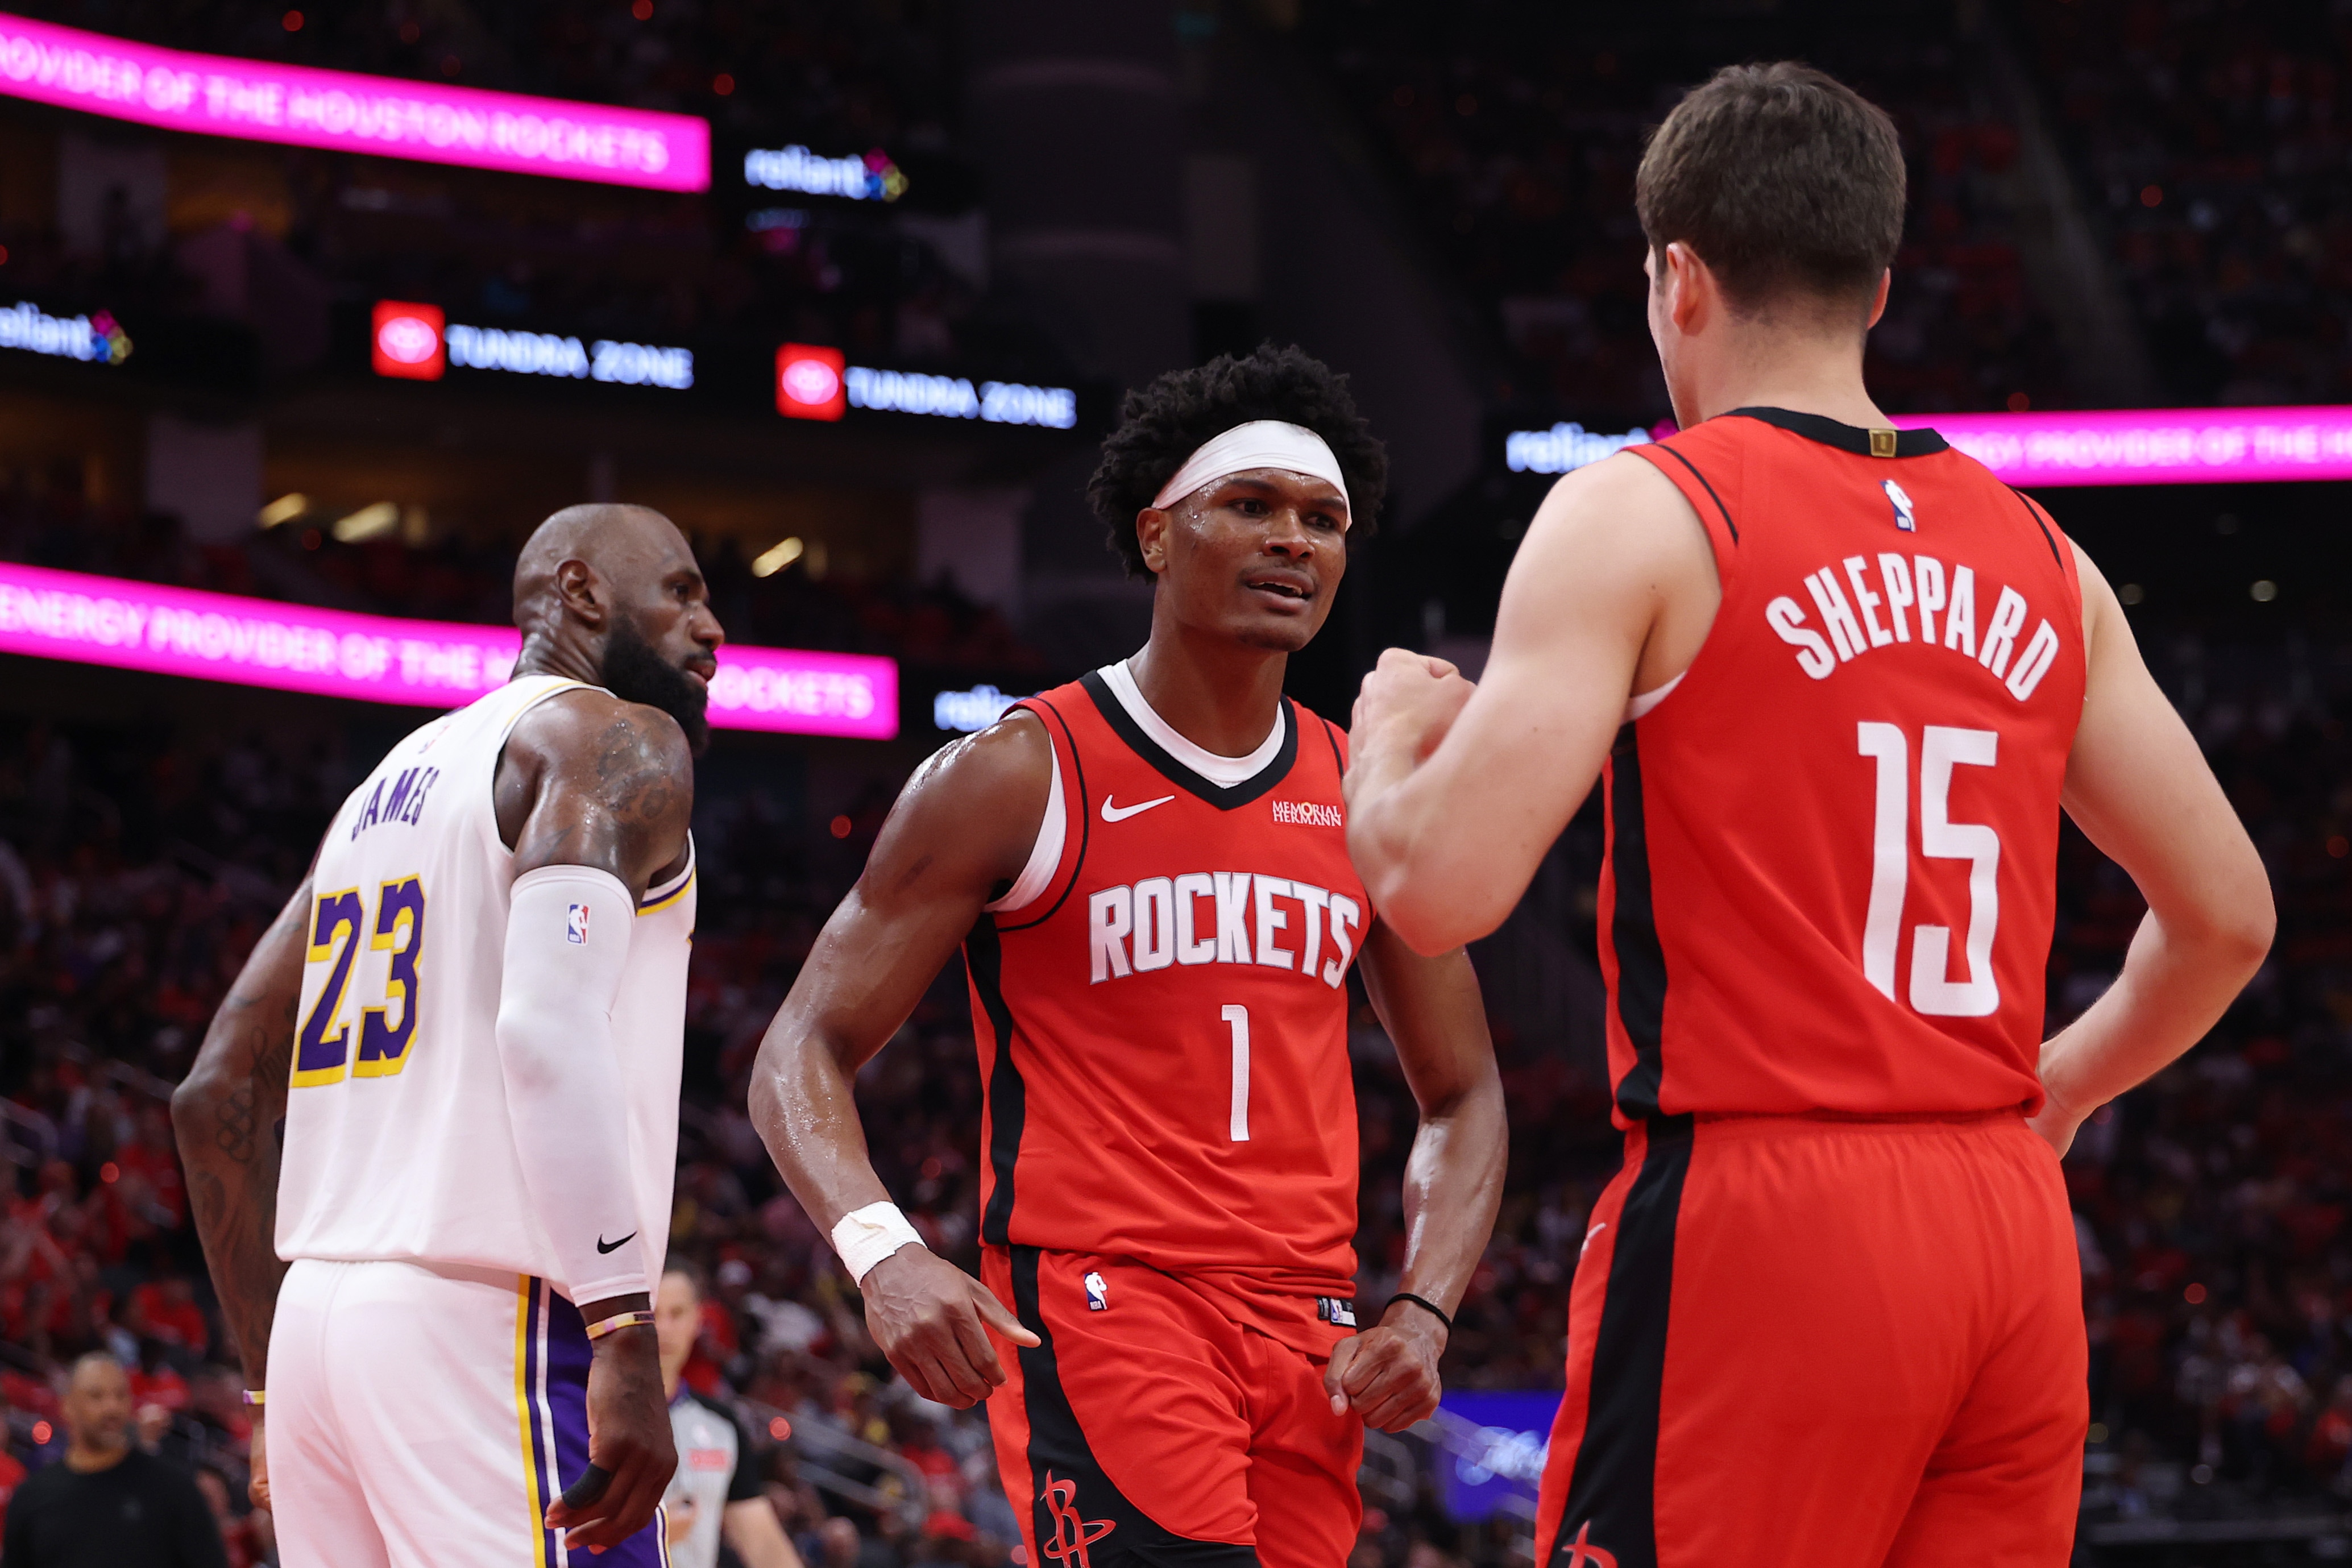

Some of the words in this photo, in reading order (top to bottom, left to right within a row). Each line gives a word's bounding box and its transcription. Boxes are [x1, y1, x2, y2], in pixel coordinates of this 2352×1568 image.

[0, 34, 142, 103] OVIDER
[143, 67, 200, 111] OF
[205, 75, 284, 126] THE
[287, 83, 489, 152] HOUSTON
[490, 109, 669, 174] ROCKETS
[0, 301, 96, 360] eliant
[446, 323, 589, 378] TUNDRA
[591, 339, 692, 389] ZONE
[844, 366, 979, 417] TUNDRA
[980, 380, 1075, 429] ZONE
[147, 606, 340, 675] PROVIDER
[339, 632, 395, 681] OF
[397, 639, 481, 691] THE
[707, 663, 876, 720] OCKETS
[1765, 552, 2059, 703] SHEPPARD
[351, 766, 440, 842] JAMES
[1272, 800, 1342, 818] MEMORIAL
[1273, 809, 1342, 827] HERMANN
[1857, 721, 2000, 1017] 15
[290, 873, 427, 1088] 23
[1088, 870, 1361, 990] ROCKETS
[1221, 1004, 1250, 1142] 1
